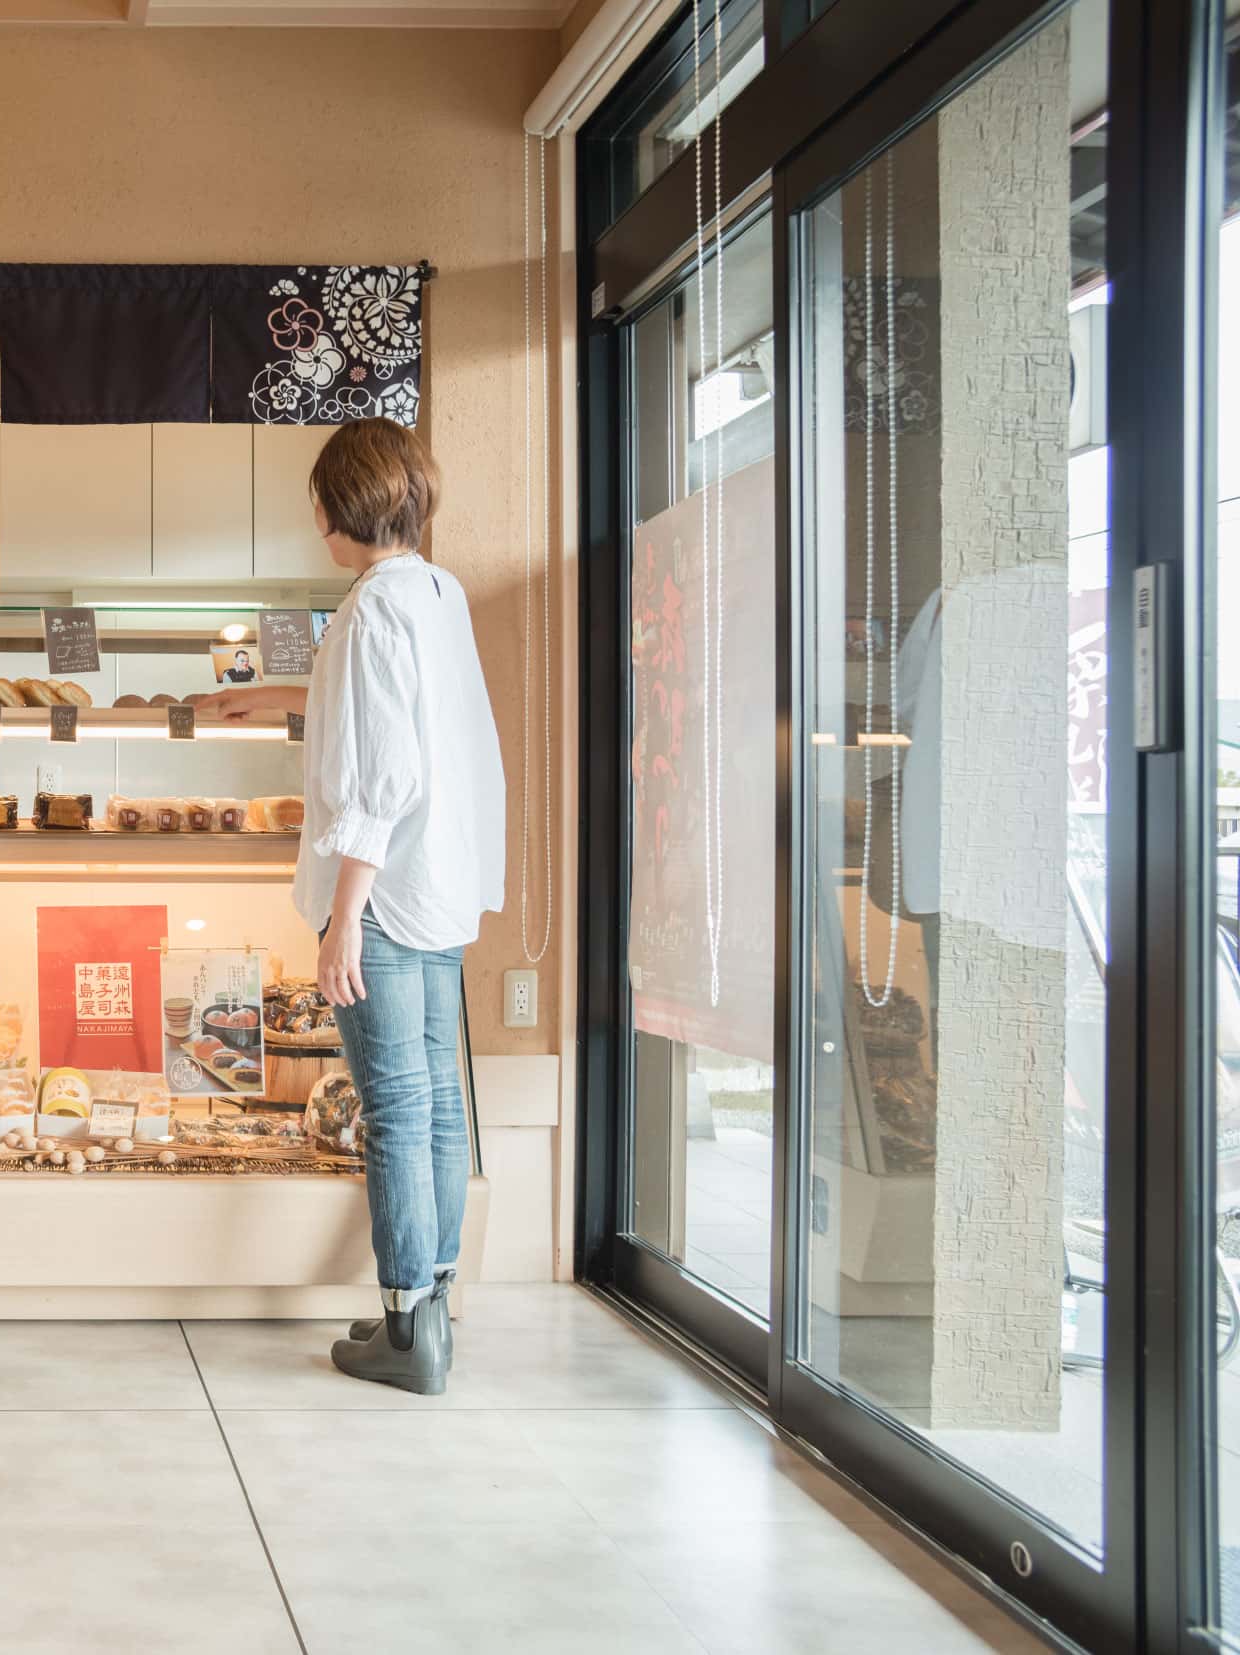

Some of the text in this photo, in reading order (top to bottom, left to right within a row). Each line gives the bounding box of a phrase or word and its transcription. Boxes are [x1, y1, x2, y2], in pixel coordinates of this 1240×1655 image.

[78, 966, 96, 1016] 中島屋
[96, 966, 112, 1016] 菓子司
[113, 966, 131, 1015] 遠州森
[77, 1025, 134, 1033] NAKAJIMAYA
